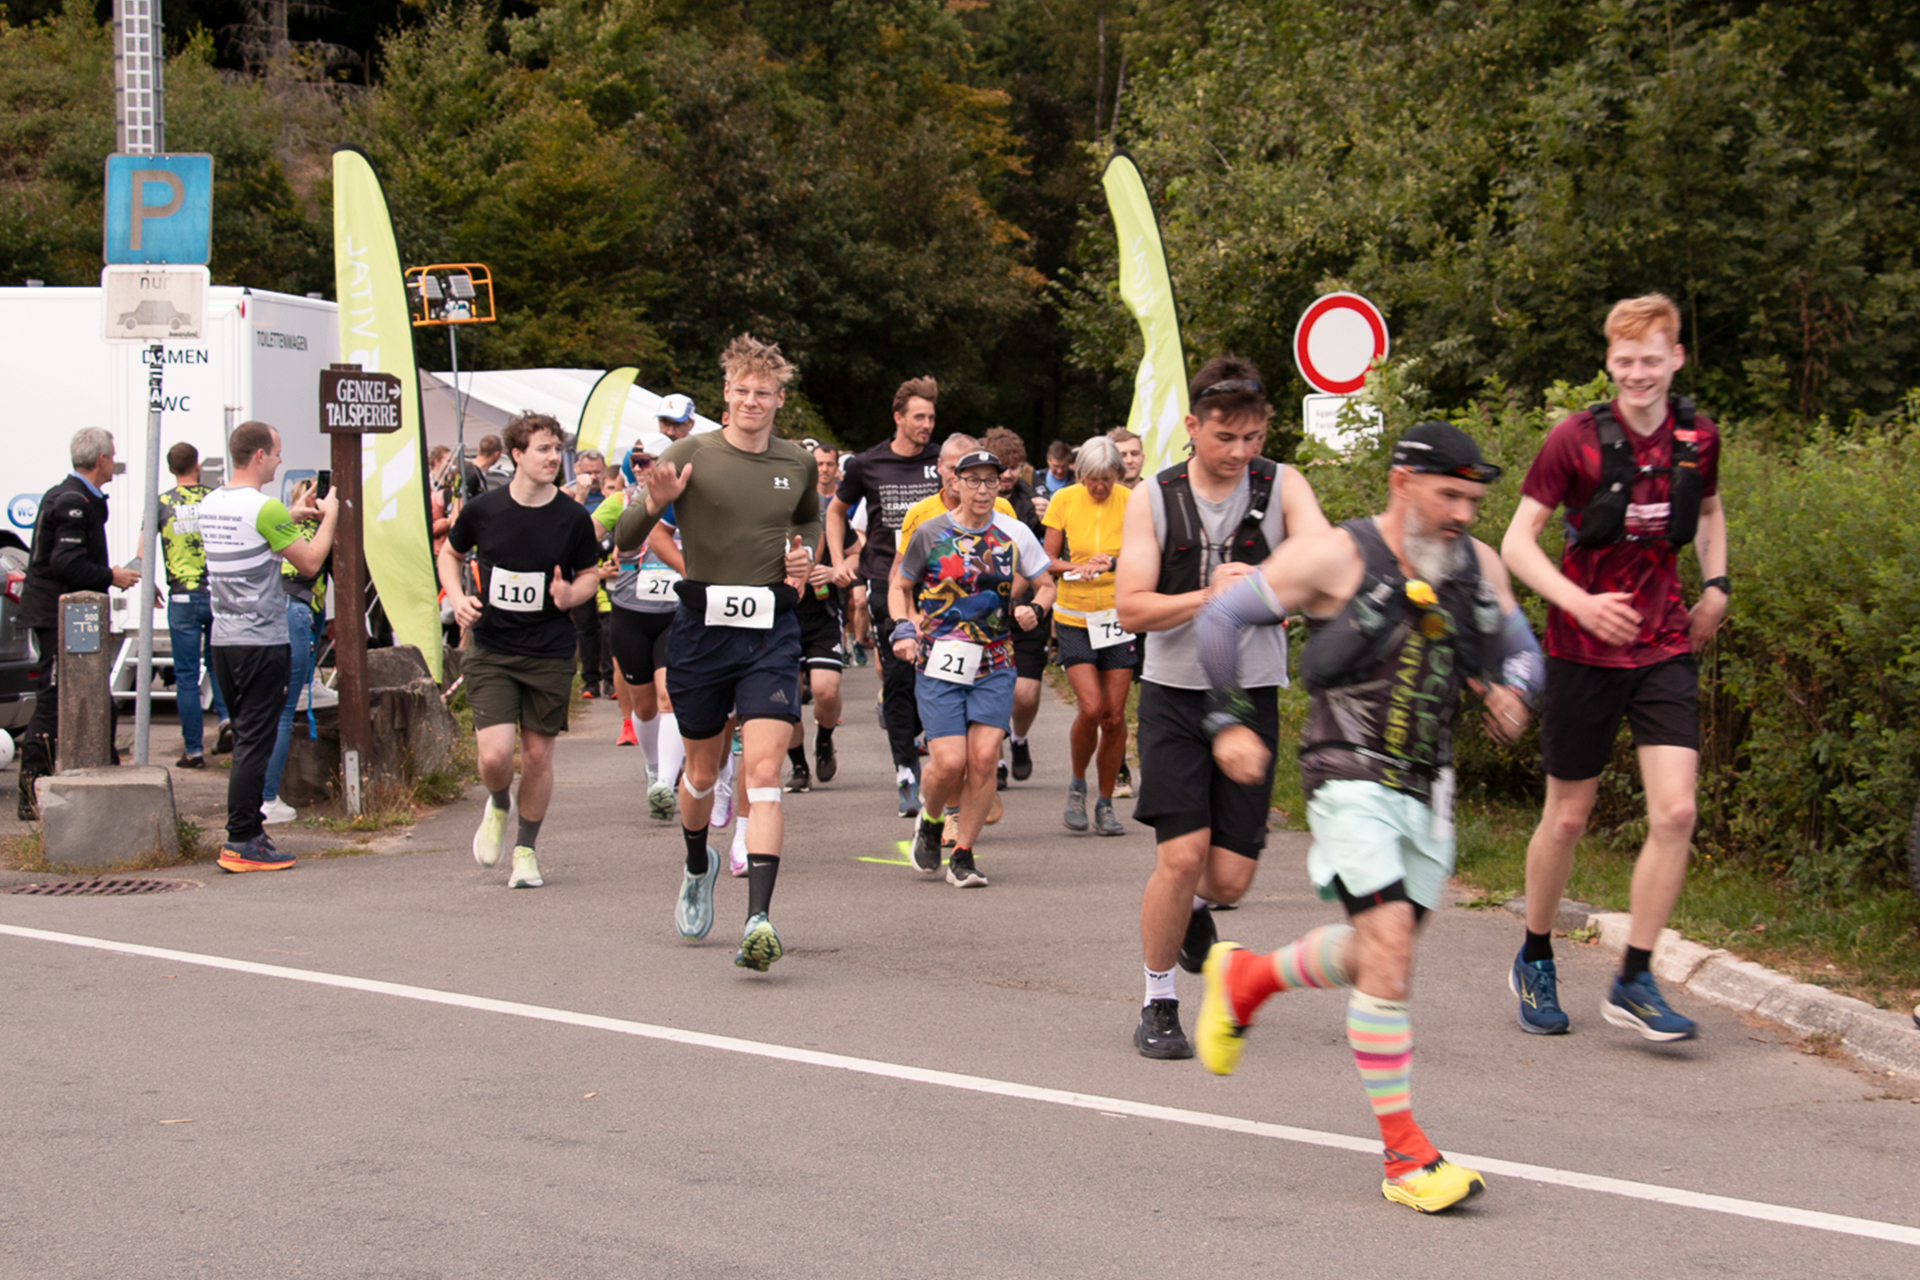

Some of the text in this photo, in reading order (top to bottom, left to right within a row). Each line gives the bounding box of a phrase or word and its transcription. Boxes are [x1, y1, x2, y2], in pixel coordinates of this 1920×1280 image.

[129, 169, 185, 251] P
[140, 276, 171, 289] nur
[256, 330, 308, 352] TOILETTENWAGEN
[142, 349, 208, 364] DMEN
[336, 378, 390, 403] GENKEL
[161, 396, 190, 412] WC
[325, 403, 398, 427] TALSPERRE
[923, 465, 939, 479] K
[17, 506, 34, 517] WC
[497, 584, 536, 604] 110
[648, 579, 671, 595] 27
[723, 596, 757, 618] 50
[84, 613, 99, 621] 500
[1100, 620, 1124, 639] 75
[939, 653, 965, 675] 21
